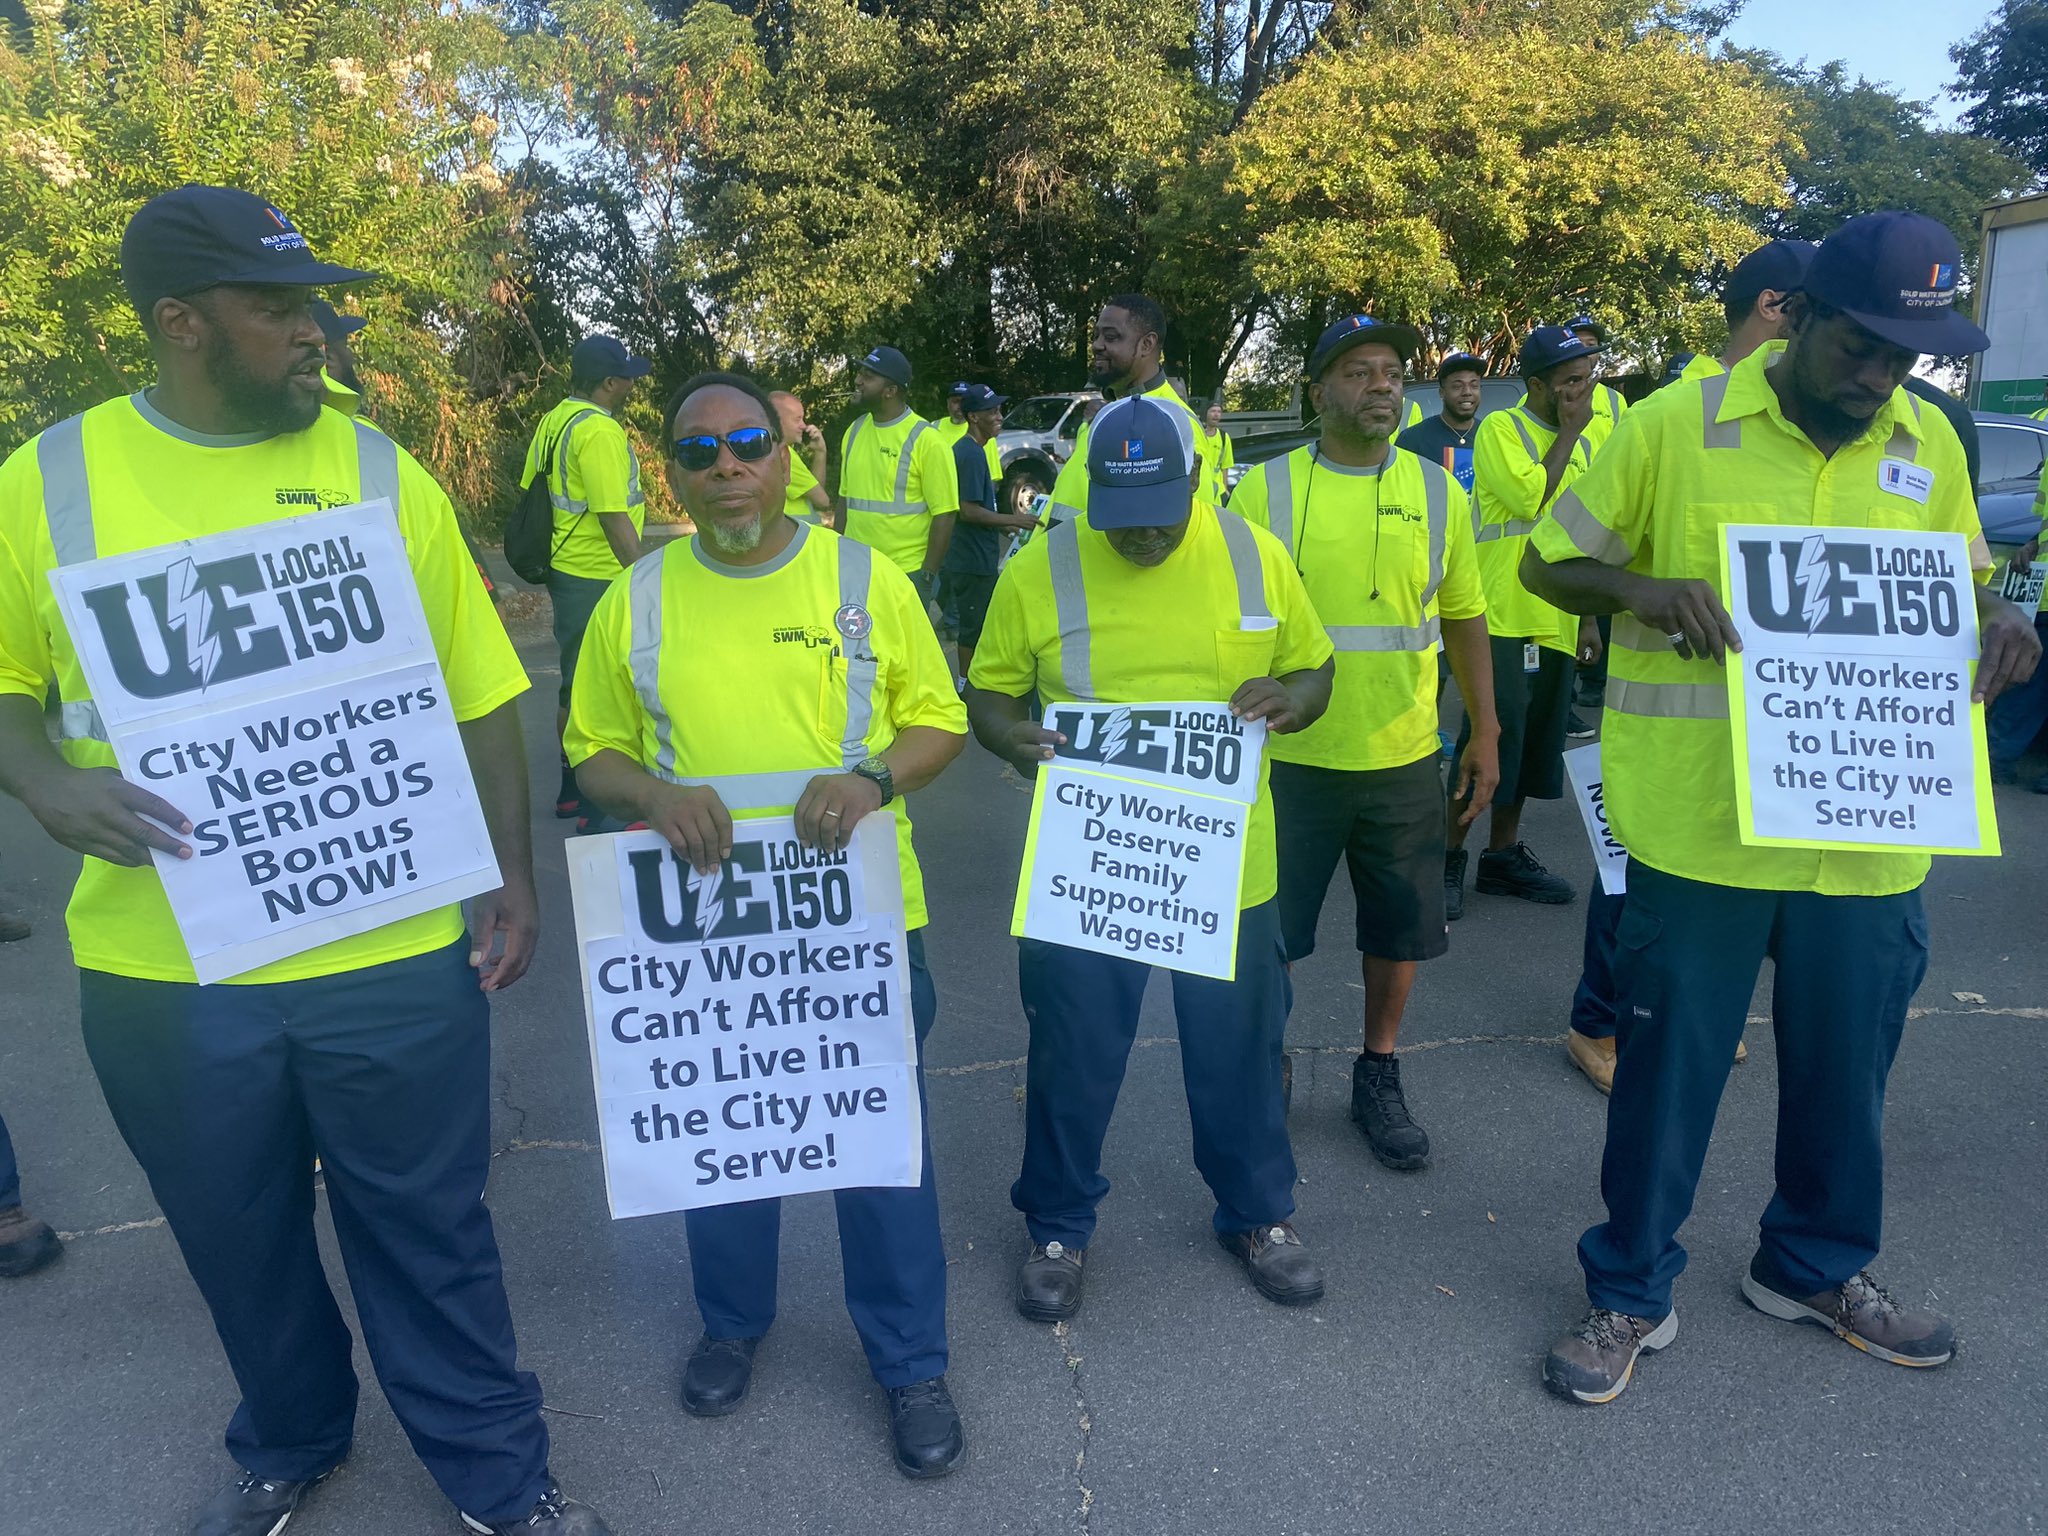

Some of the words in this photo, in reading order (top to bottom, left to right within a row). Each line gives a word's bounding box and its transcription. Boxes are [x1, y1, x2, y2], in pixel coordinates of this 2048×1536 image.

[275, 242, 291, 251] CITY
[1900, 289, 1918, 297] SOLID
[2002, 392, 2044, 402] Commercial
[1133, 465, 1159, 474] DURHAM
[275, 493, 317, 505] SWM
[1378, 507, 1402, 516] SWM
[262, 535, 367, 589] LOCAL
[1738, 538, 1880, 637] UE
[1875, 546, 1955, 579] LOCAL
[279, 575, 385, 660] 150
[1879, 579, 1961, 637] 150
[2025, 581, 2043, 603] 150
[81, 553, 292, 700] UE
[773, 631, 805, 643] SWM
[1755, 658, 1818, 691] City
[1825, 661, 1960, 692] Workers
[139, 736, 236, 781] City
[243, 686, 438, 754] Workers
[1174, 711, 1244, 737] LOCAL
[1762, 692, 1846, 721] Can't
[1854, 697, 1955, 726] Afford
[1054, 709, 1172, 774] UE
[1171, 731, 1242, 786] 150
[1787, 731, 1822, 755] to
[1831, 730, 1896, 758] Live
[1905, 733, 1935, 760] in
[206, 738, 356, 810] Need
[369, 739, 399, 766] a
[1773, 762, 1827, 790] the
[1836, 765, 1899, 800] City
[1908, 774, 1953, 797] we
[194, 761, 434, 857] SERIOUS
[1055, 782, 1113, 818] City
[1120, 793, 1237, 839] Workers
[1815, 799, 1917, 830] Serve!
[241, 816, 414, 887] Bonus
[1083, 818, 1201, 862] Deserve
[261, 848, 419, 924] NOW!
[628, 840, 773, 944] UE
[772, 868, 852, 931] 150
[1090, 850, 1188, 896] Family
[1050, 874, 1219, 935] Supporting
[1079, 911, 1185, 955] Wages!
[598, 953, 692, 997] City
[700, 938, 893, 983] Workers
[611, 997, 733, 1044] Can't
[745, 980, 890, 1029] Afford
[650, 1056, 699, 1091] to
[712, 1042, 806, 1083] Live
[819, 1034, 861, 1072] in
[630, 1102, 710, 1144] the
[721, 1090, 812, 1134] City
[824, 1085, 888, 1118] we
[694, 1133, 838, 1186] Serve!
